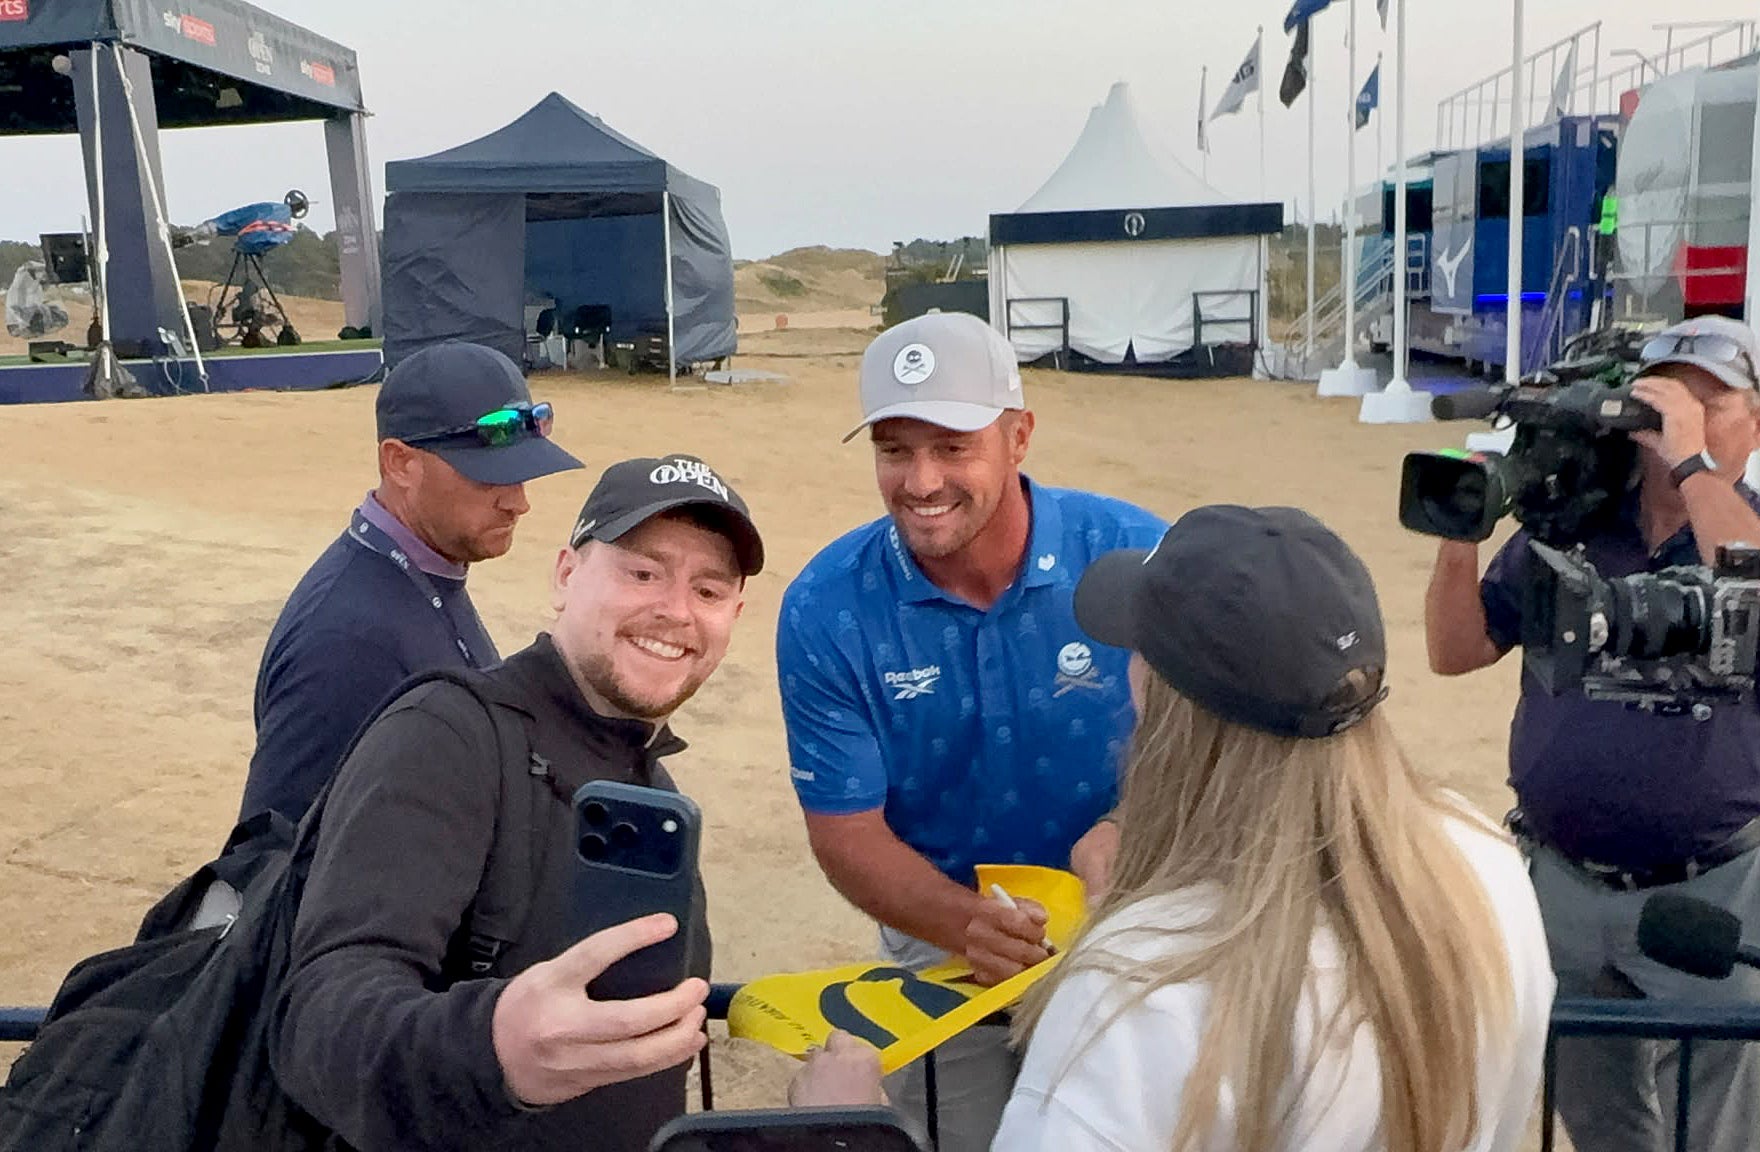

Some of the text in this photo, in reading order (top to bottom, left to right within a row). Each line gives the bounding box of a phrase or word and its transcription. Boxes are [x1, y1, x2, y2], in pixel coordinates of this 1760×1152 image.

[674, 458, 711, 476] THE
[650, 464, 728, 502] OPEN
[884, 665, 941, 685] Reebok
